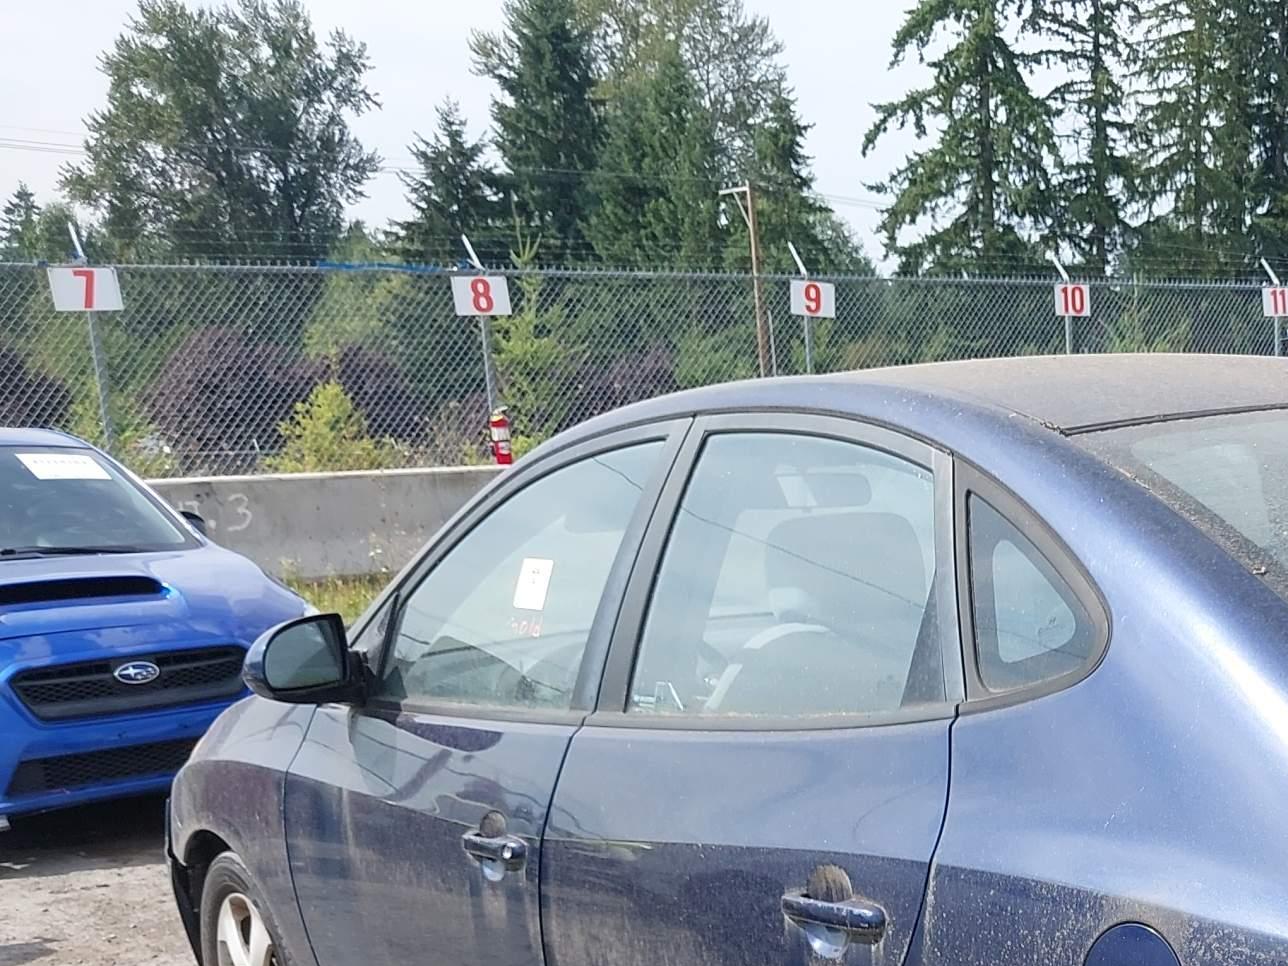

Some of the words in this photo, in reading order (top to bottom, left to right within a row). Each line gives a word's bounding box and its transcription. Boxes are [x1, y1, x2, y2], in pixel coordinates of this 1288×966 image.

[73, 270, 94, 309] 7
[471, 279, 493, 312] 8
[805, 284, 821, 313] 9
[1061, 287, 1084, 314] 10
[1271, 290, 1287, 314] 11
